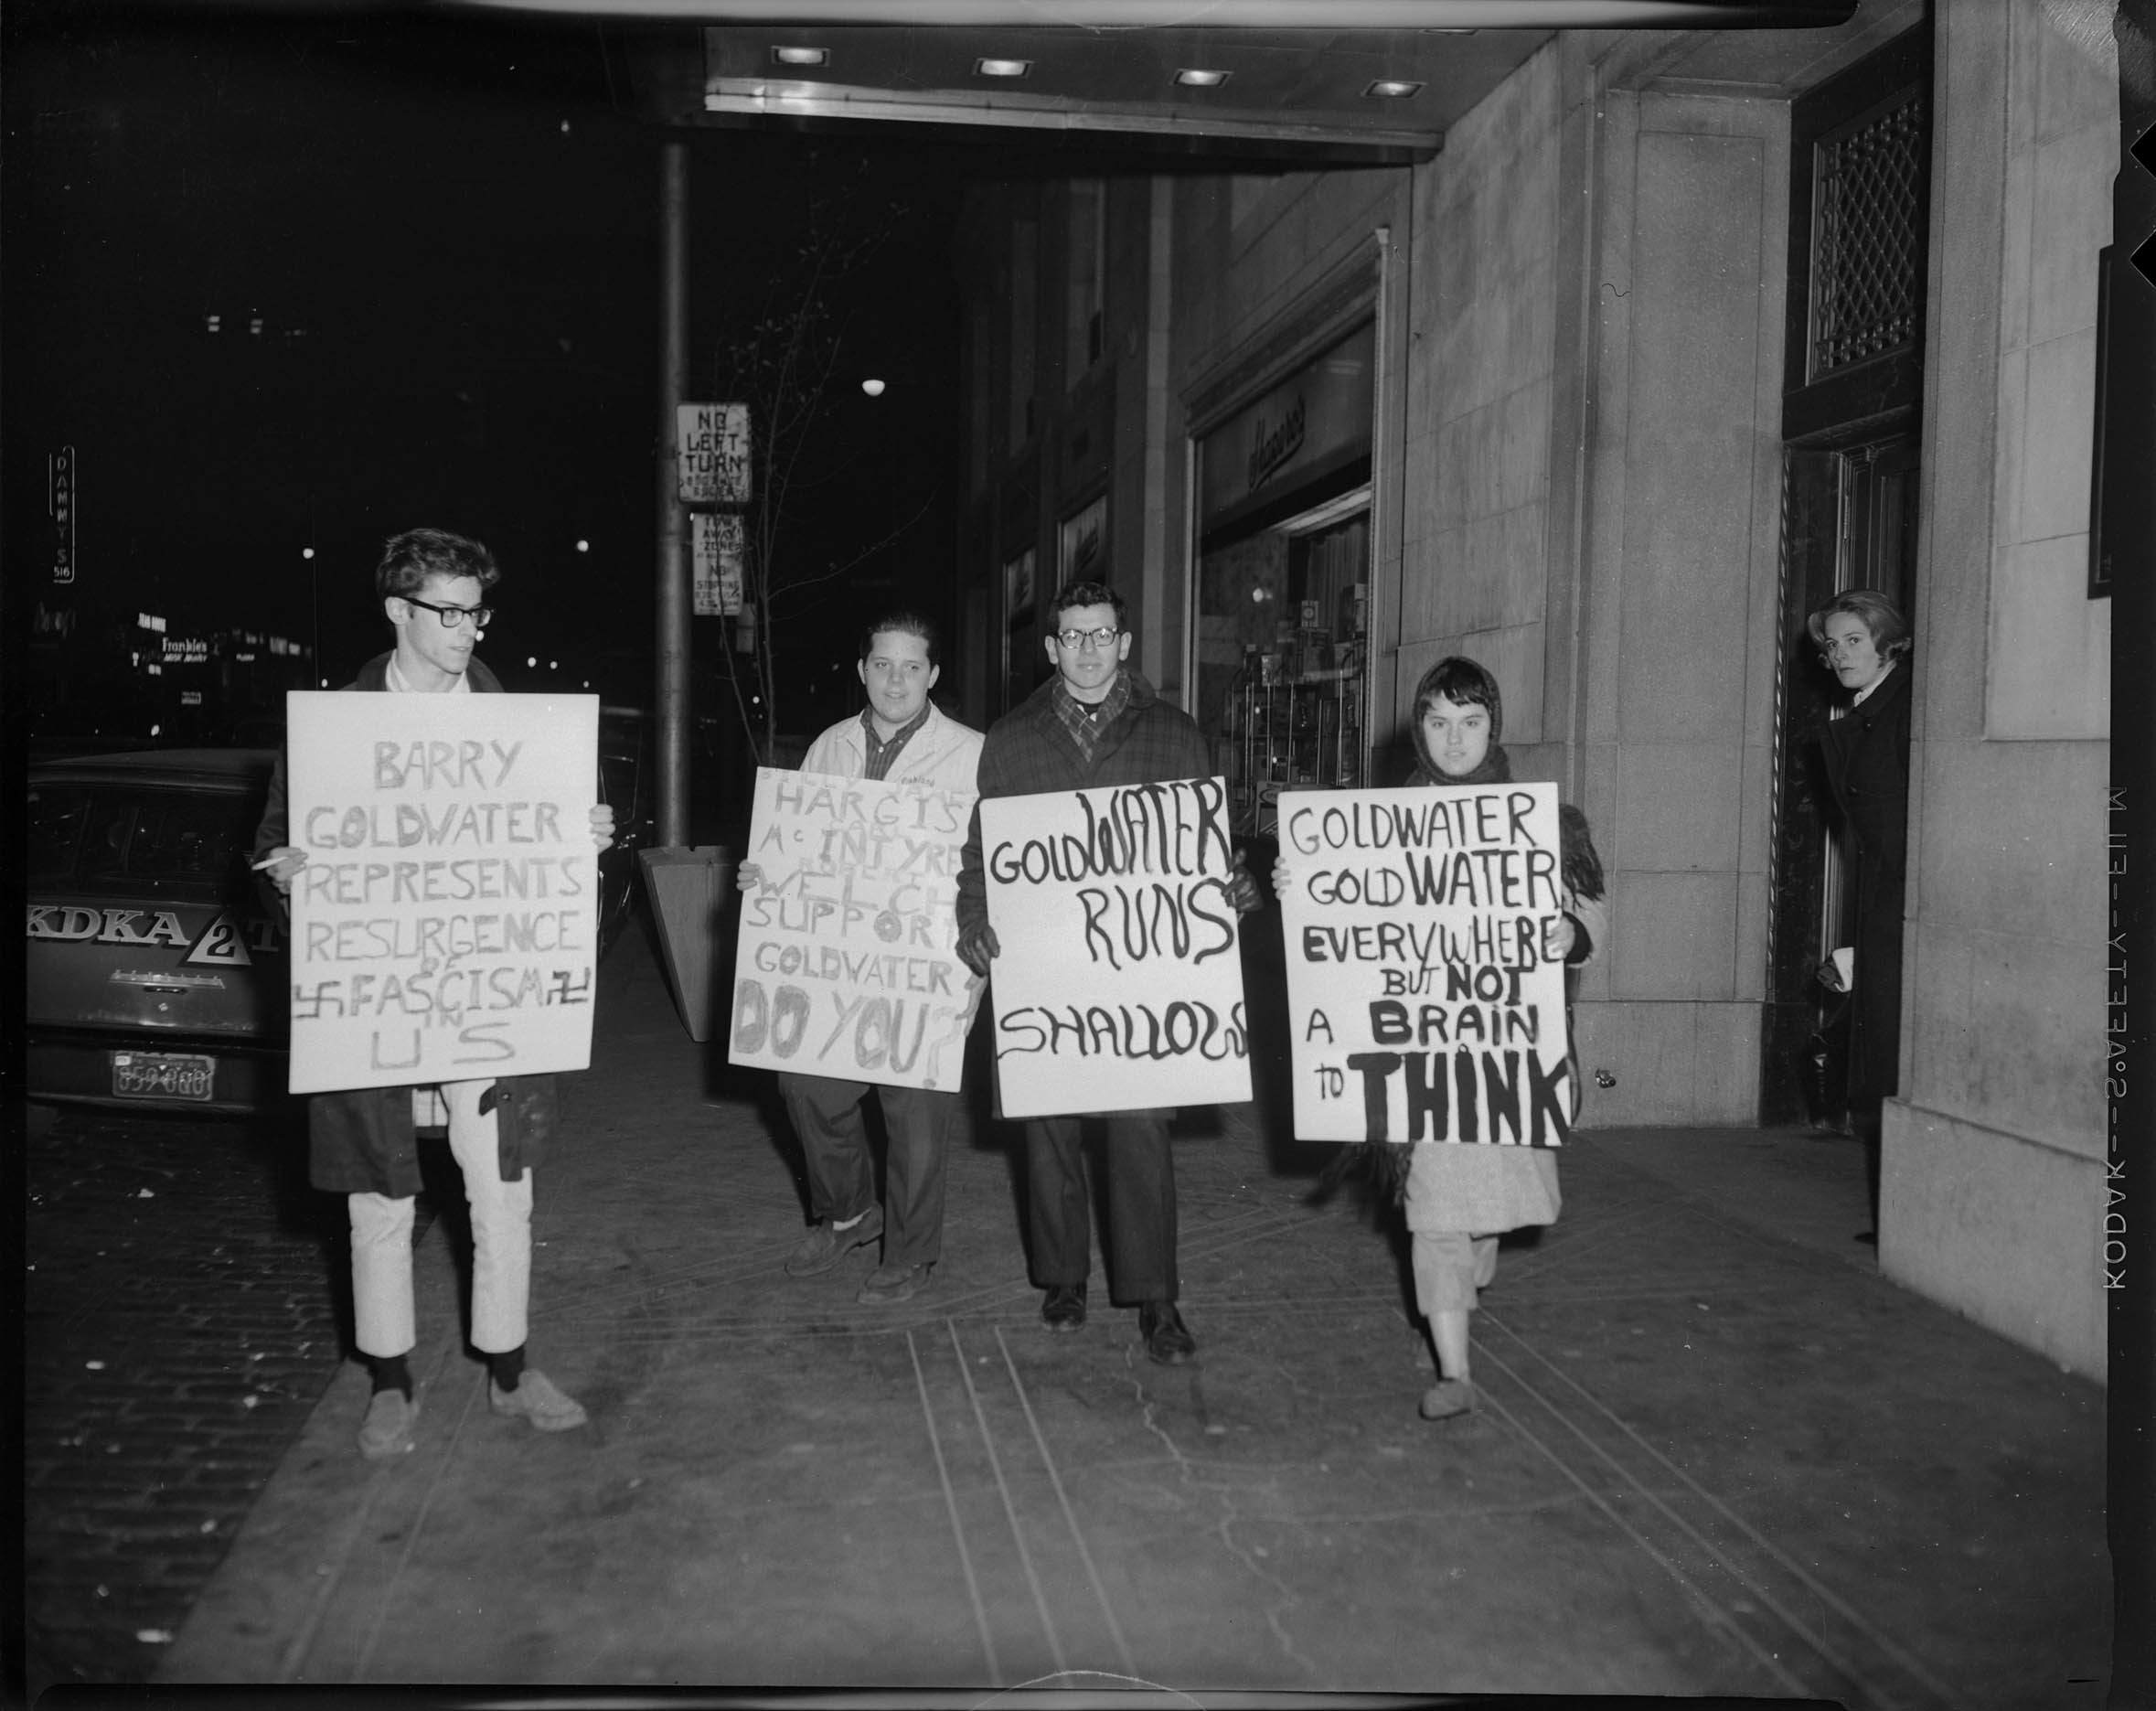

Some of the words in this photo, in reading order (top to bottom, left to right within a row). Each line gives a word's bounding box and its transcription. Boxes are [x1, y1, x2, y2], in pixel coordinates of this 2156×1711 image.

[687, 433, 740, 453] LEFT
[698, 411, 728, 432] NO
[686, 454, 742, 474] TURN
[53, 565, 70, 578] 516
[373, 740, 524, 790] BARRY
[304, 802, 562, 850] GOLDWATER
[774, 783, 963, 833] HARGIS
[990, 778, 1234, 885] GOLDWATER
[1289, 792, 1537, 855] GOLDWATER
[303, 855, 585, 906] REPRESENTS
[1307, 849, 1561, 910] GOLDWATER
[26, 904, 191, 946] KDKA
[207, 924, 236, 958] 2
[306, 911, 582, 962] RESURGENCE
[1076, 877, 1235, 971] RUNS
[1303, 914, 1564, 966] EVERYWHERE
[349, 968, 544, 1017] FASCISM
[754, 942, 953, 997] GOLDWATER
[1381, 967, 1441, 997] BUT
[1446, 964, 1535, 1006] NOT
[423, 1011, 464, 1028] IN
[732, 978, 812, 1060] DO
[1307, 1009, 1334, 1044] A
[1369, 1000, 1540, 1047] BRAIN
[1346, 1045, 1571, 1148] THINK
